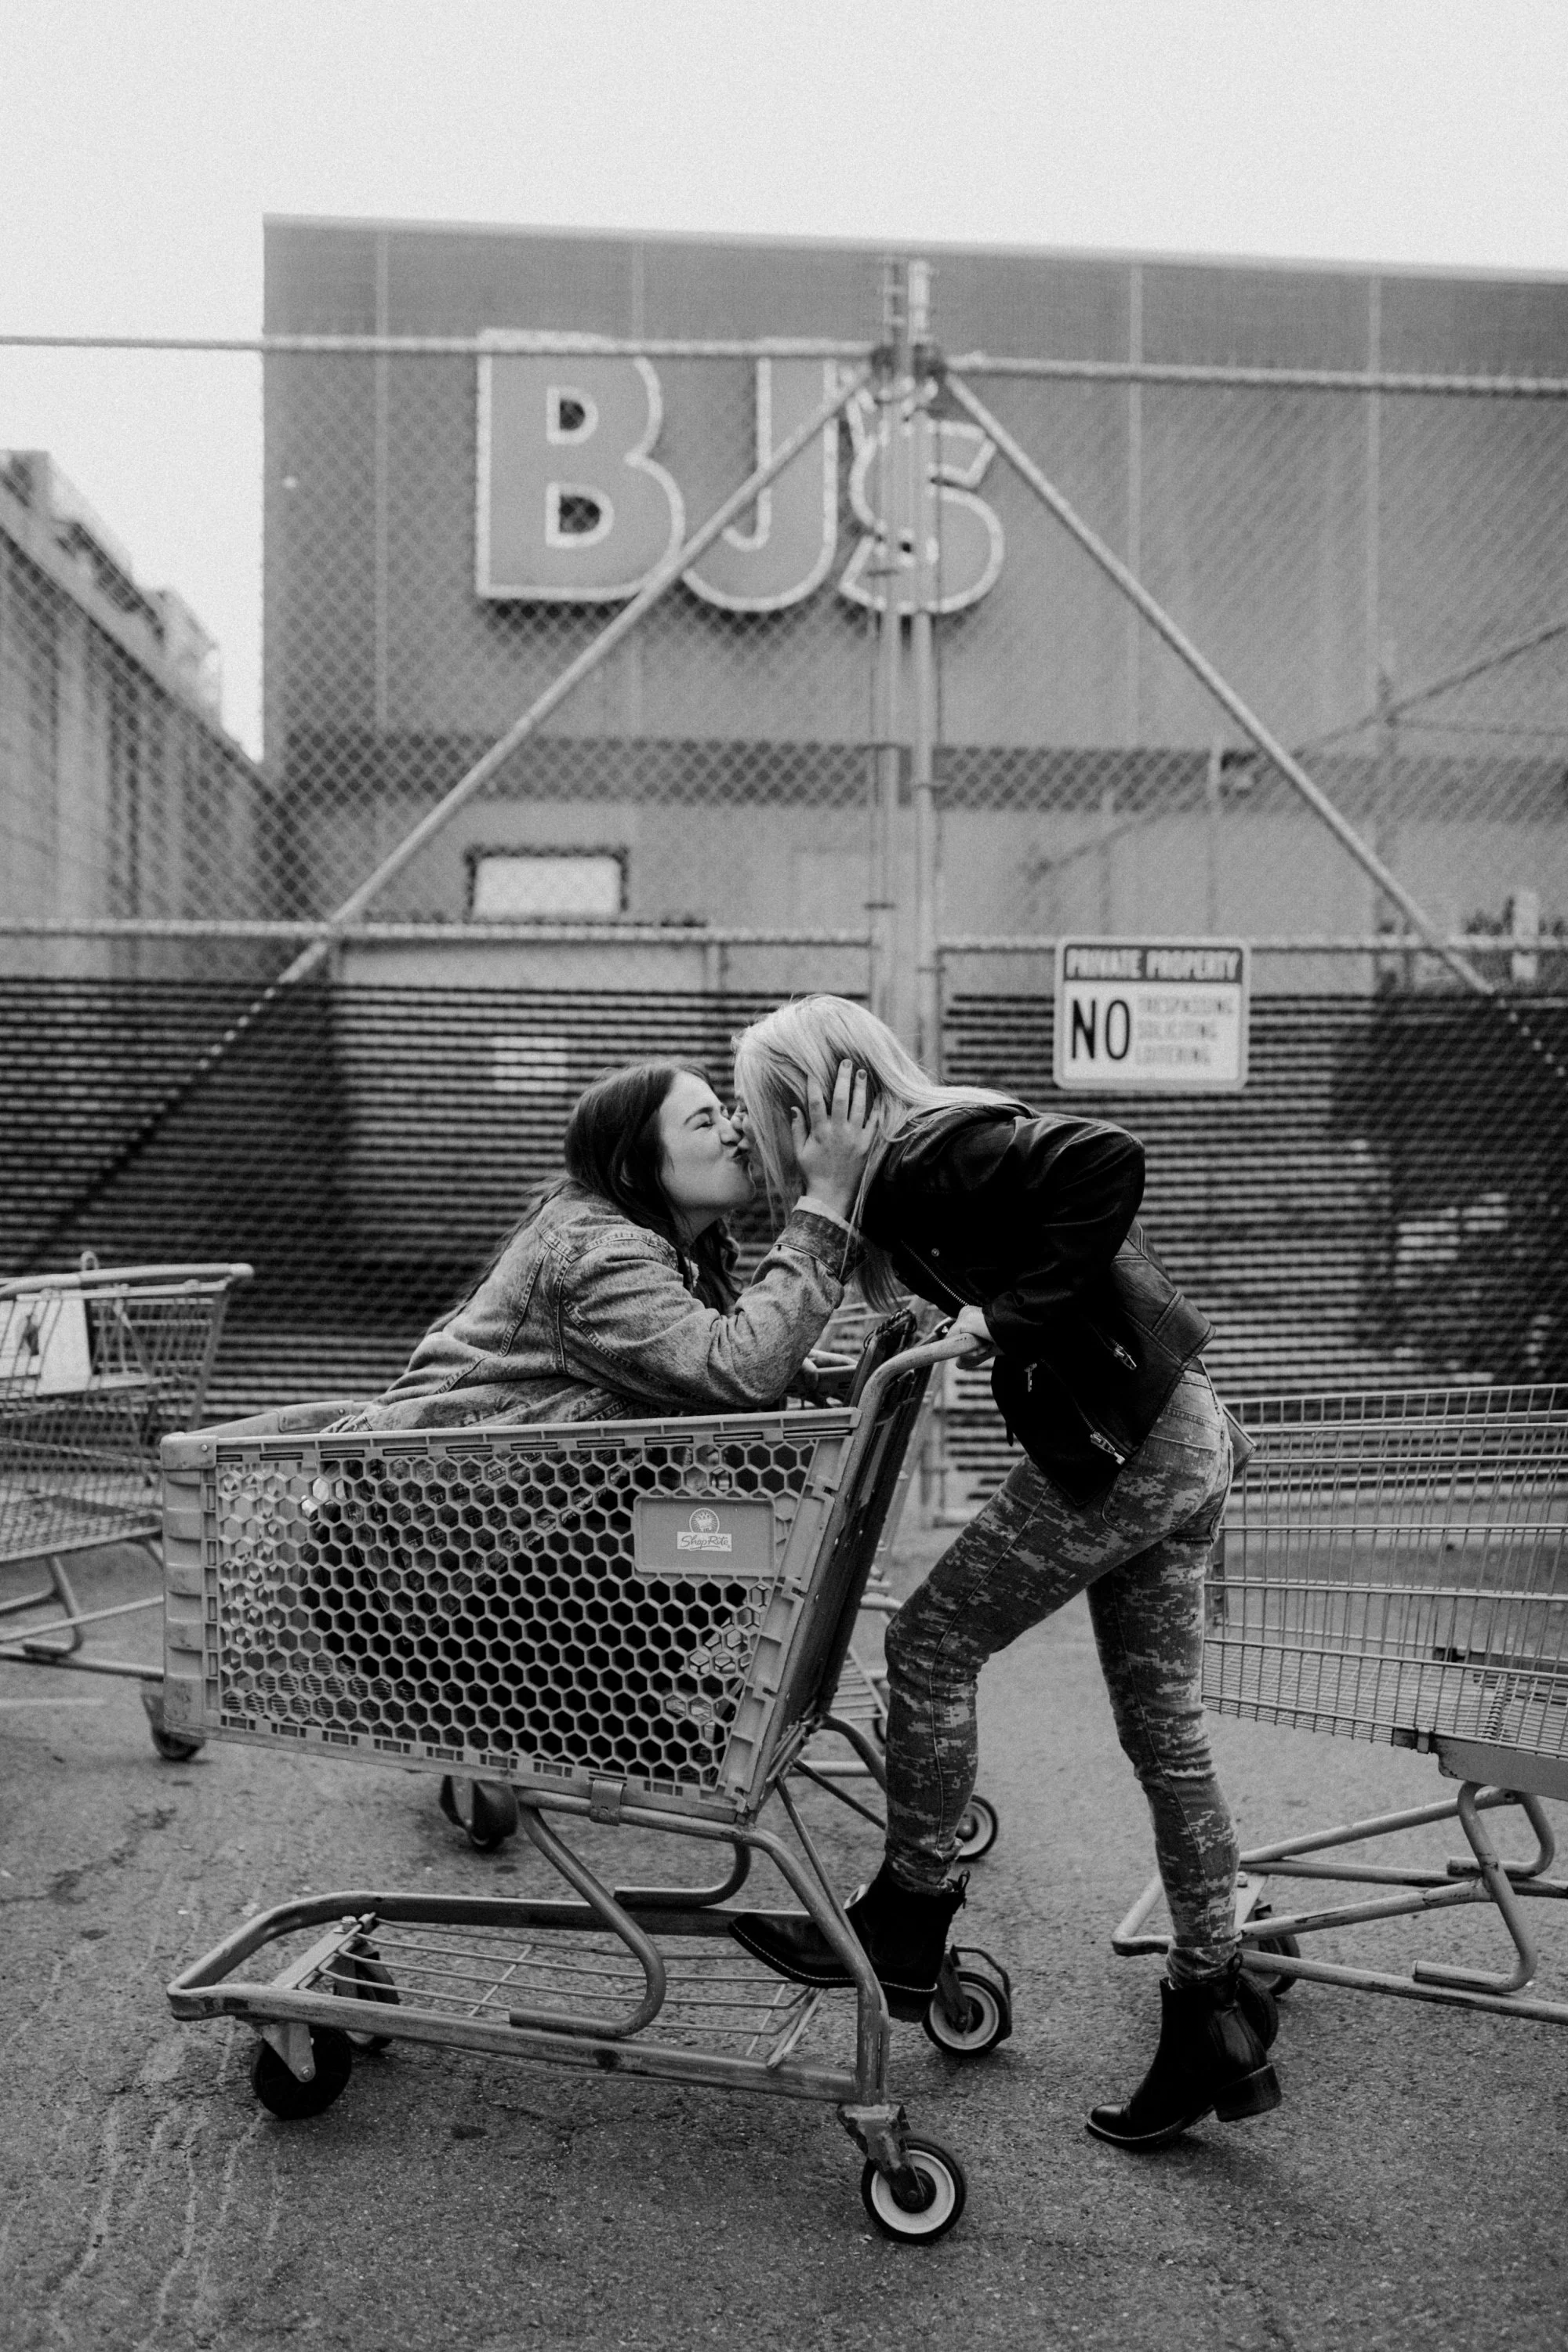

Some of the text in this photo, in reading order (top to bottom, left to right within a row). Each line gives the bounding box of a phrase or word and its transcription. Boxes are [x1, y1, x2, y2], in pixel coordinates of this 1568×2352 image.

[1066, 948, 1240, 980] PRIVATE PROPERTY
[1071, 999, 1131, 1061] NO
[681, 1534, 728, 1550] ShopRite
